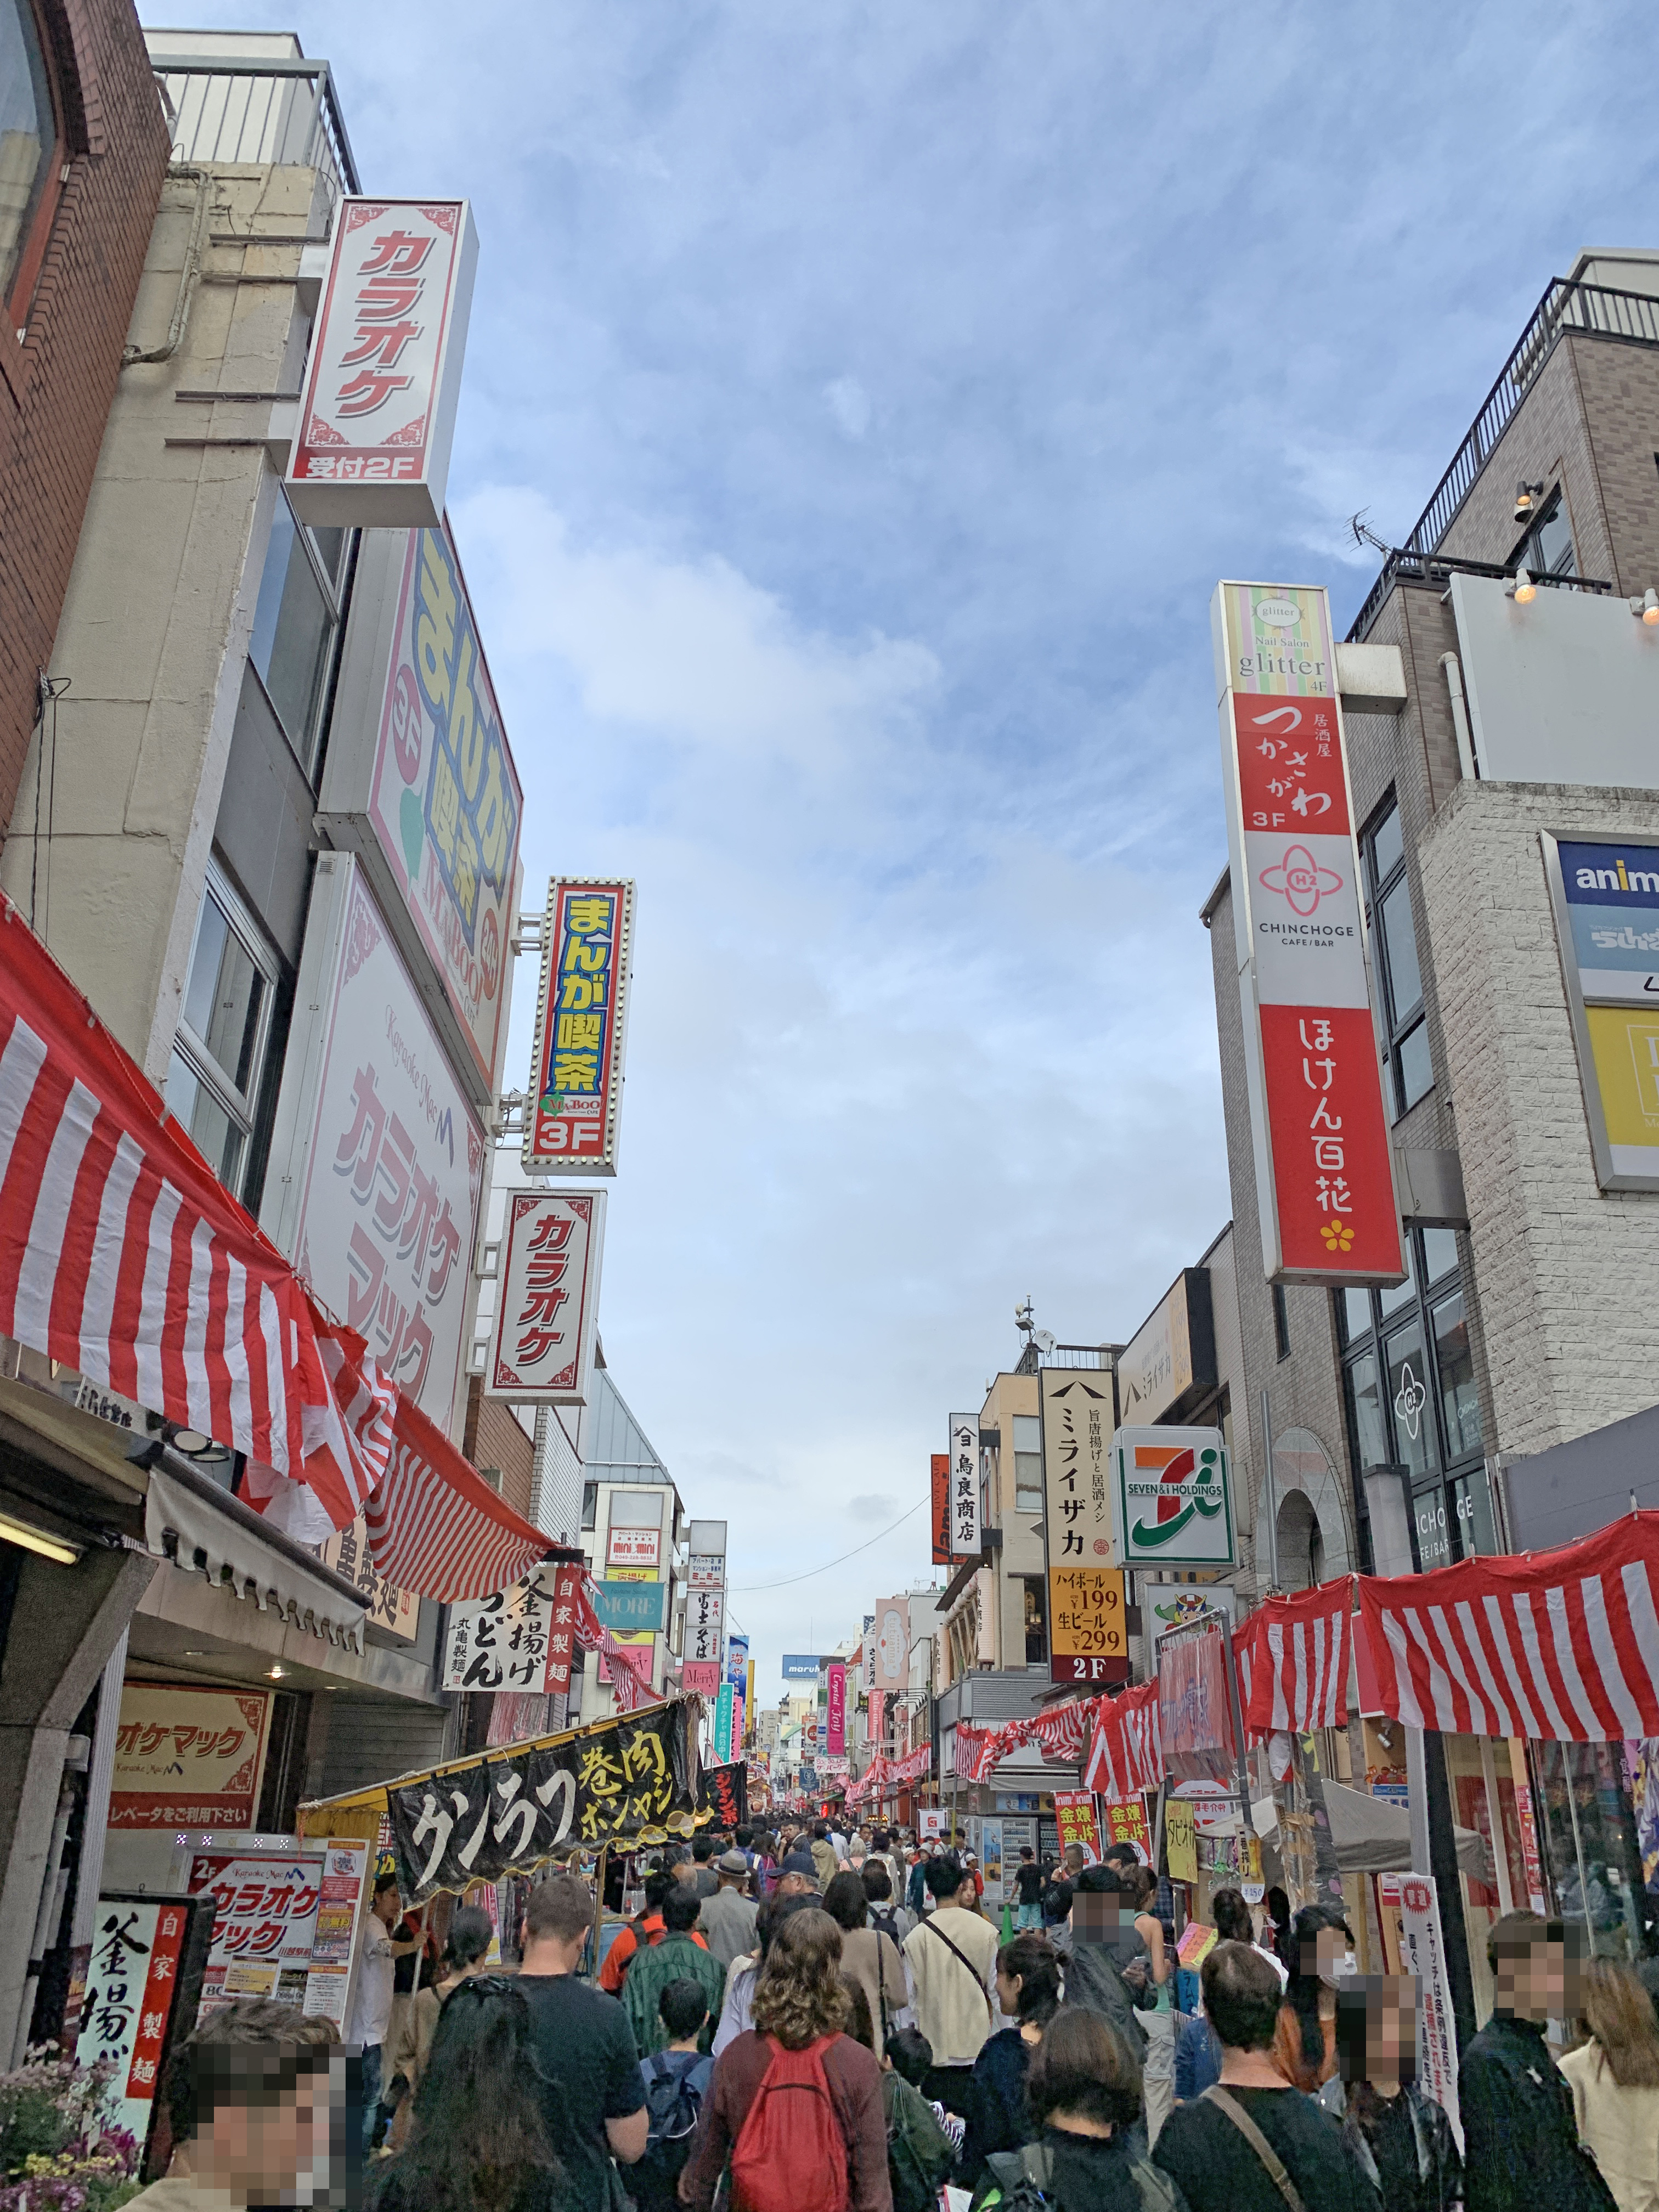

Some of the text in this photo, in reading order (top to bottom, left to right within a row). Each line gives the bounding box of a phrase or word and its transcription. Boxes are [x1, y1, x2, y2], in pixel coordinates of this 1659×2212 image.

[335, 230, 437, 419] カラオケ
[306, 456, 415, 479] 受付2F
[1262, 606, 1295, 618] glitter
[1255, 636, 1310, 648] Nail Salon
[1239, 652, 1326, 678] glitter
[1310, 681, 1328, 692] 4F
[393, 674, 421, 761] 3F
[415, 528, 514, 893] まんが
[1314, 713, 1333, 758] 居酒屋
[1253, 812, 1285, 827] 3F
[1260, 923, 1354, 936] CHINCHOGE
[1282, 939, 1334, 947] CAFE/BAR
[553, 898, 613, 1092] まんが喫茶
[1299, 1019, 1352, 1212] ほけん百花
[539, 1121, 601, 1150] 3F
[333, 1062, 462, 1308] カラオケ
[516, 1212, 574, 1367] カラオケ
[347, 1221, 433, 1406] マック
[1057, 1408, 1086, 1556] ミライザカ
[1089, 1409, 1105, 1523] 旨唐揚げと居酒メシ
[956, 1454, 975, 1542] 鳥良商店
[1172, 1484, 1222, 1496] HOLDINGS
[1056, 1572, 1105, 1589] ハイボール
[507, 1573, 555, 1685] 釜揚げ
[548, 1578, 574, 1682] 自家製麺
[1058, 1611, 1108, 1629] 生ビール
[451, 1617, 471, 1672] 丸亀製麺
[686, 1669, 716, 1688] Merry
[1073, 1657, 1107, 1679] 2F
[833, 1674, 842, 1706] Crystal
[116, 1722, 246, 1758] オケマック
[195, 1859, 217, 1880] 2F
[1238, 1831, 1250, 1877] 一番搾り
[232, 1867, 265, 1878] Karaoke
[266, 1869, 284, 1879] Mac
[210, 1882, 320, 1920] カラオケ
[131, 1912, 178, 2084] 自家製麺
